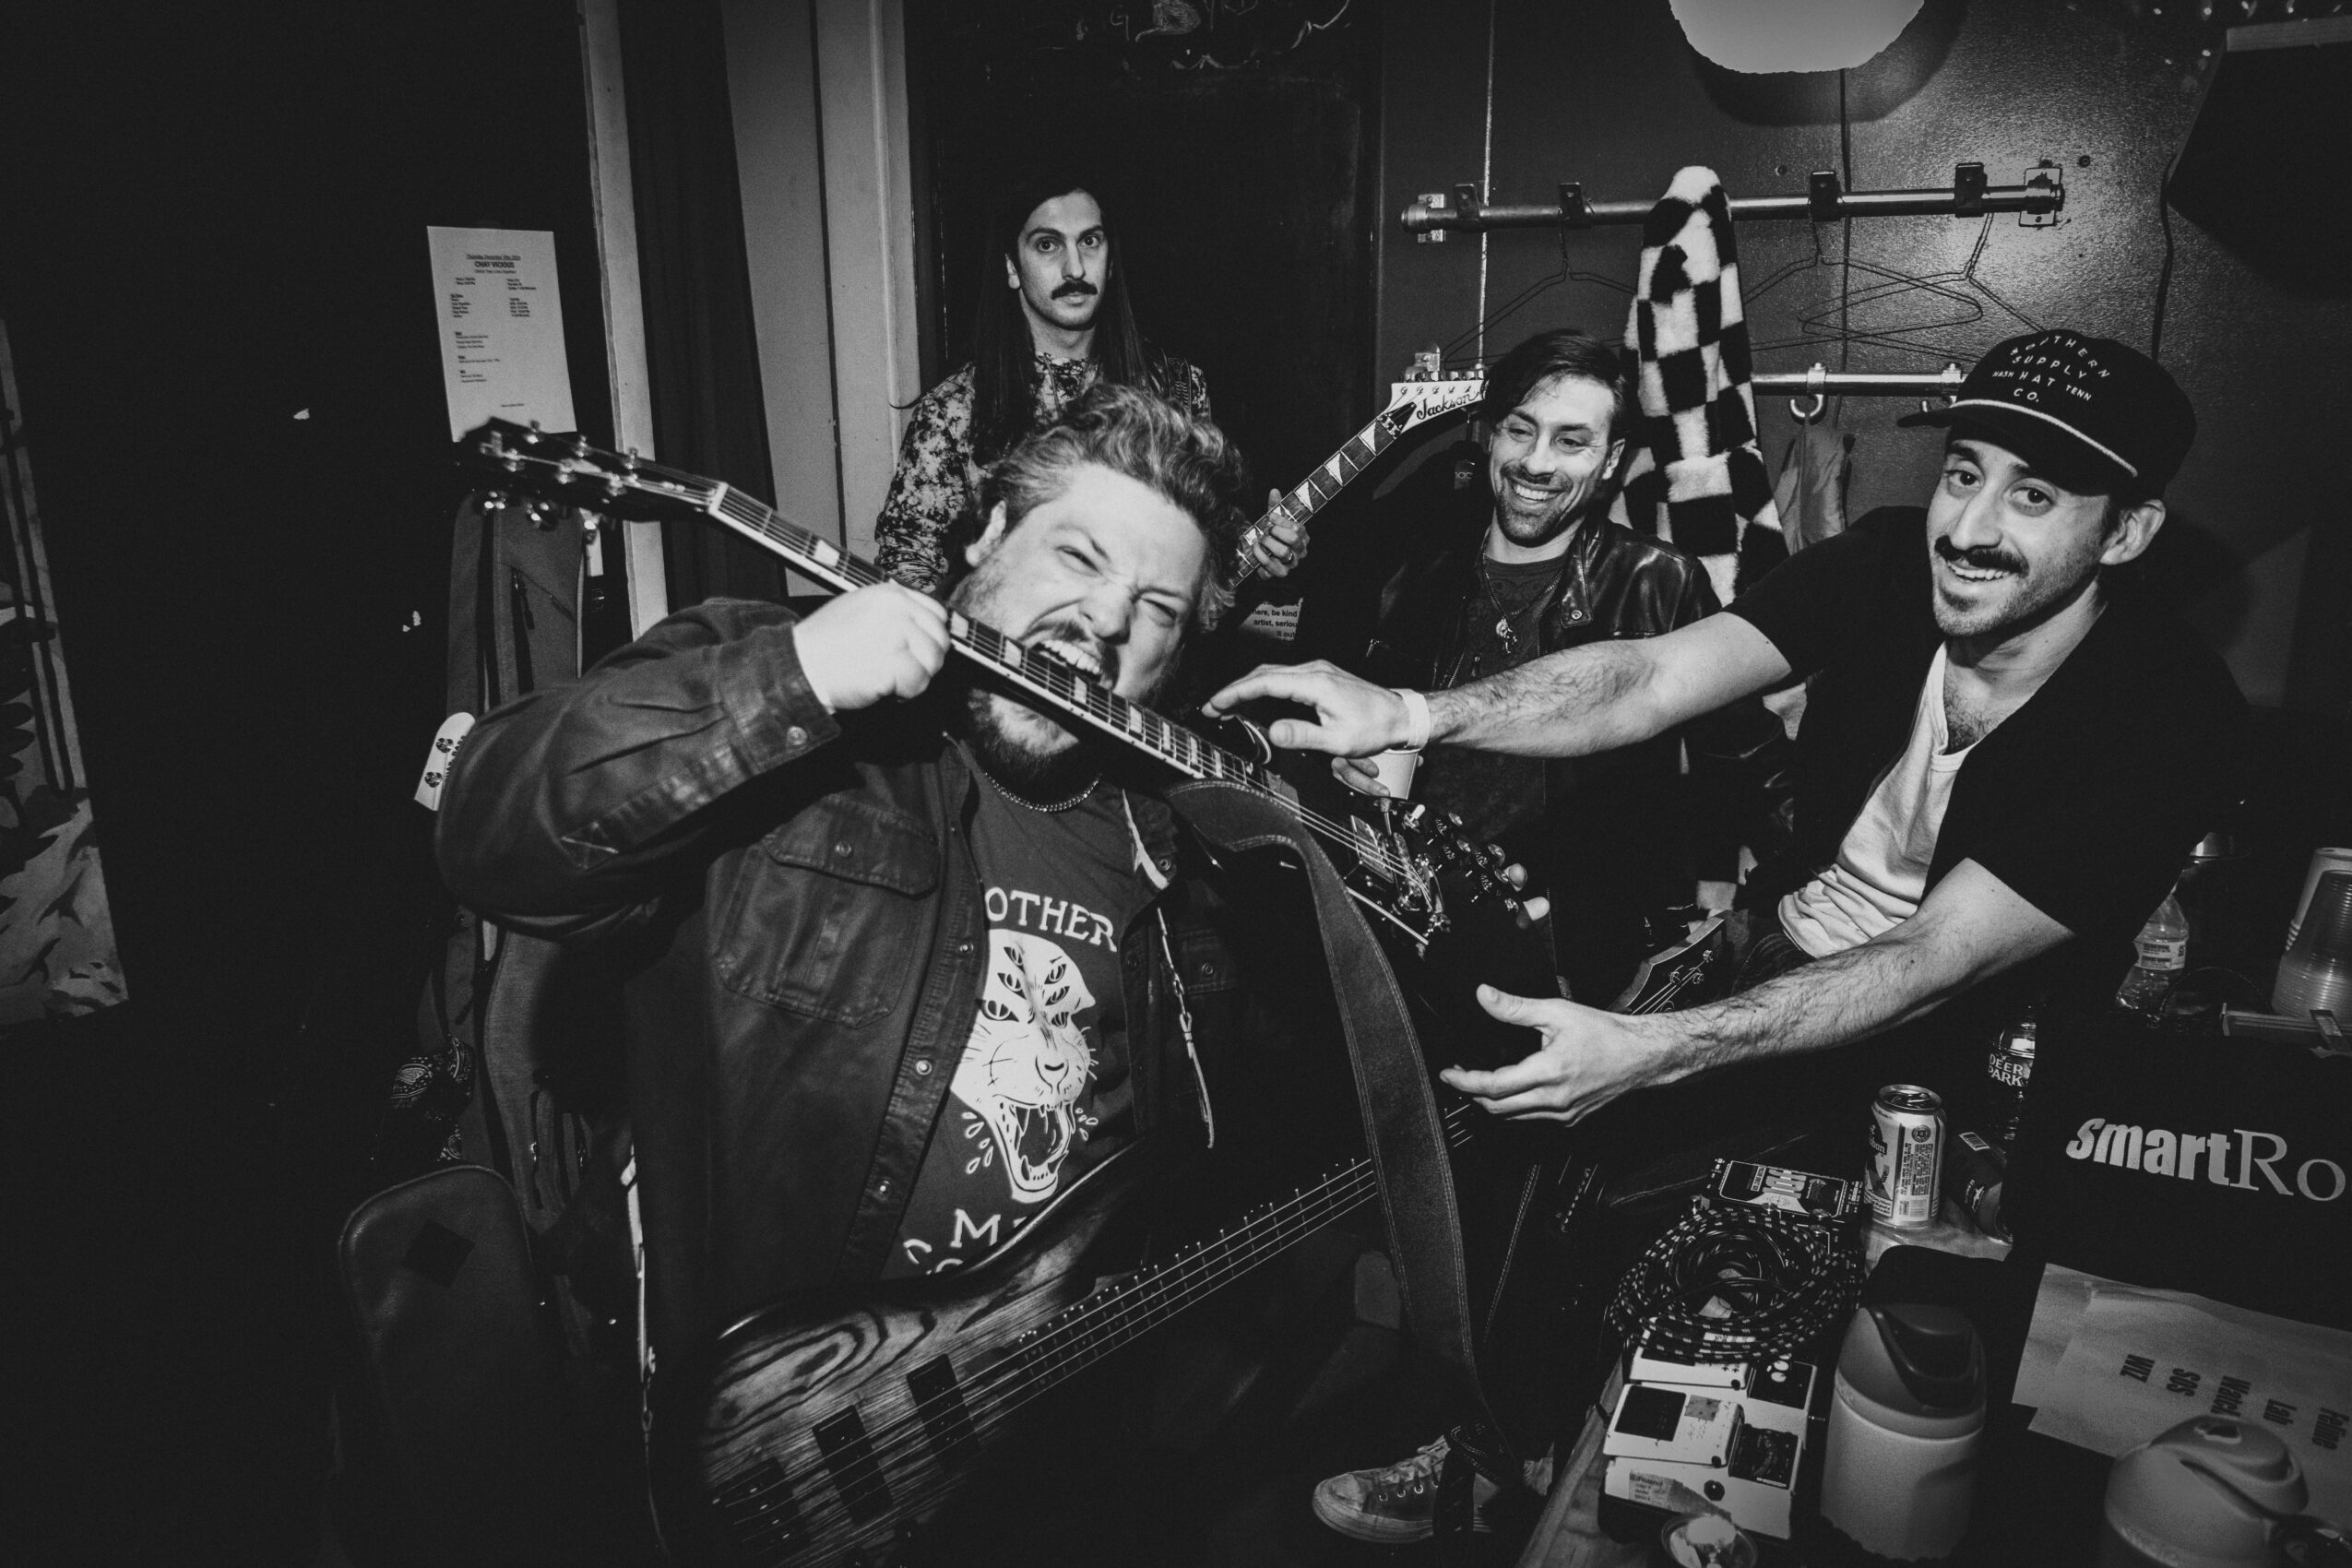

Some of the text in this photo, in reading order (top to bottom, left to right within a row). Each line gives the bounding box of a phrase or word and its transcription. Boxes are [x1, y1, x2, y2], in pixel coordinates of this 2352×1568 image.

[2012, 354, 2087, 379] SUPPLY
[2013, 387, 2039, 403] CO.
[2018, 371, 2056, 387] HAT
[2065, 384, 2092, 401] TENN
[1416, 391, 1479, 421] Jackson
[1253, 619, 1274, 627] artist,
[1282, 609, 1298, 618] kind
[1988, 1064, 2023, 1087] PARK
[1990, 1052, 2024, 1077] DEER
[2166, 1367, 2202, 1397] SOS
[2311, 1407, 2350, 1451] Feline
